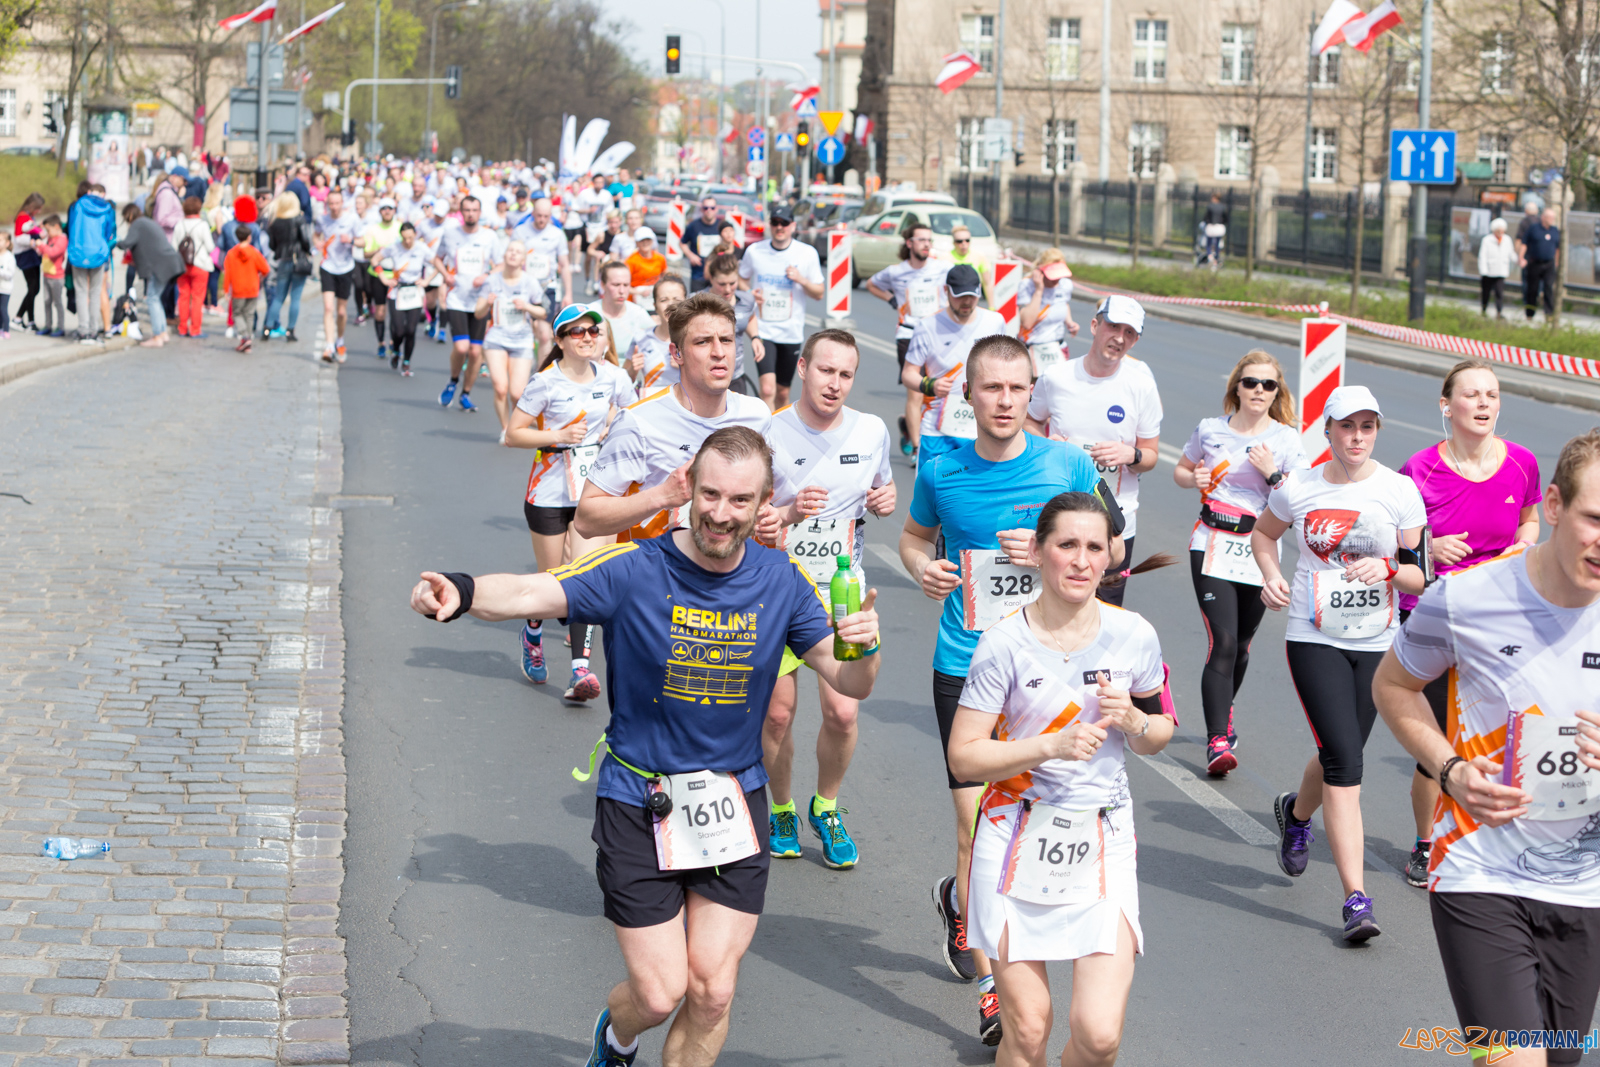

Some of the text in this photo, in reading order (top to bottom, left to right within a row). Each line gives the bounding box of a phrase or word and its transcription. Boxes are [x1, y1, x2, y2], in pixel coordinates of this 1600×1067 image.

[765, 299, 787, 308] 4182
[1108, 410, 1124, 418] NIVEA
[794, 457, 807, 466] 4F
[794, 540, 842, 557] 6260
[990, 574, 1034, 597] 328
[1330, 589, 1381, 609] 8235
[671, 605, 747, 631] BERLIN
[747, 612, 757, 631] 2018
[1340, 611, 1370, 619] Agnieszka
[670, 625, 757, 641] HALBMARATHON
[1499, 644, 1523, 657] 4F
[1025, 677, 1044, 689] 4F
[1561, 778, 1593, 790] Mikołaj
[681, 796, 735, 828] 1610
[697, 827, 731, 840] Sławomir
[1037, 837, 1090, 865] 1619
